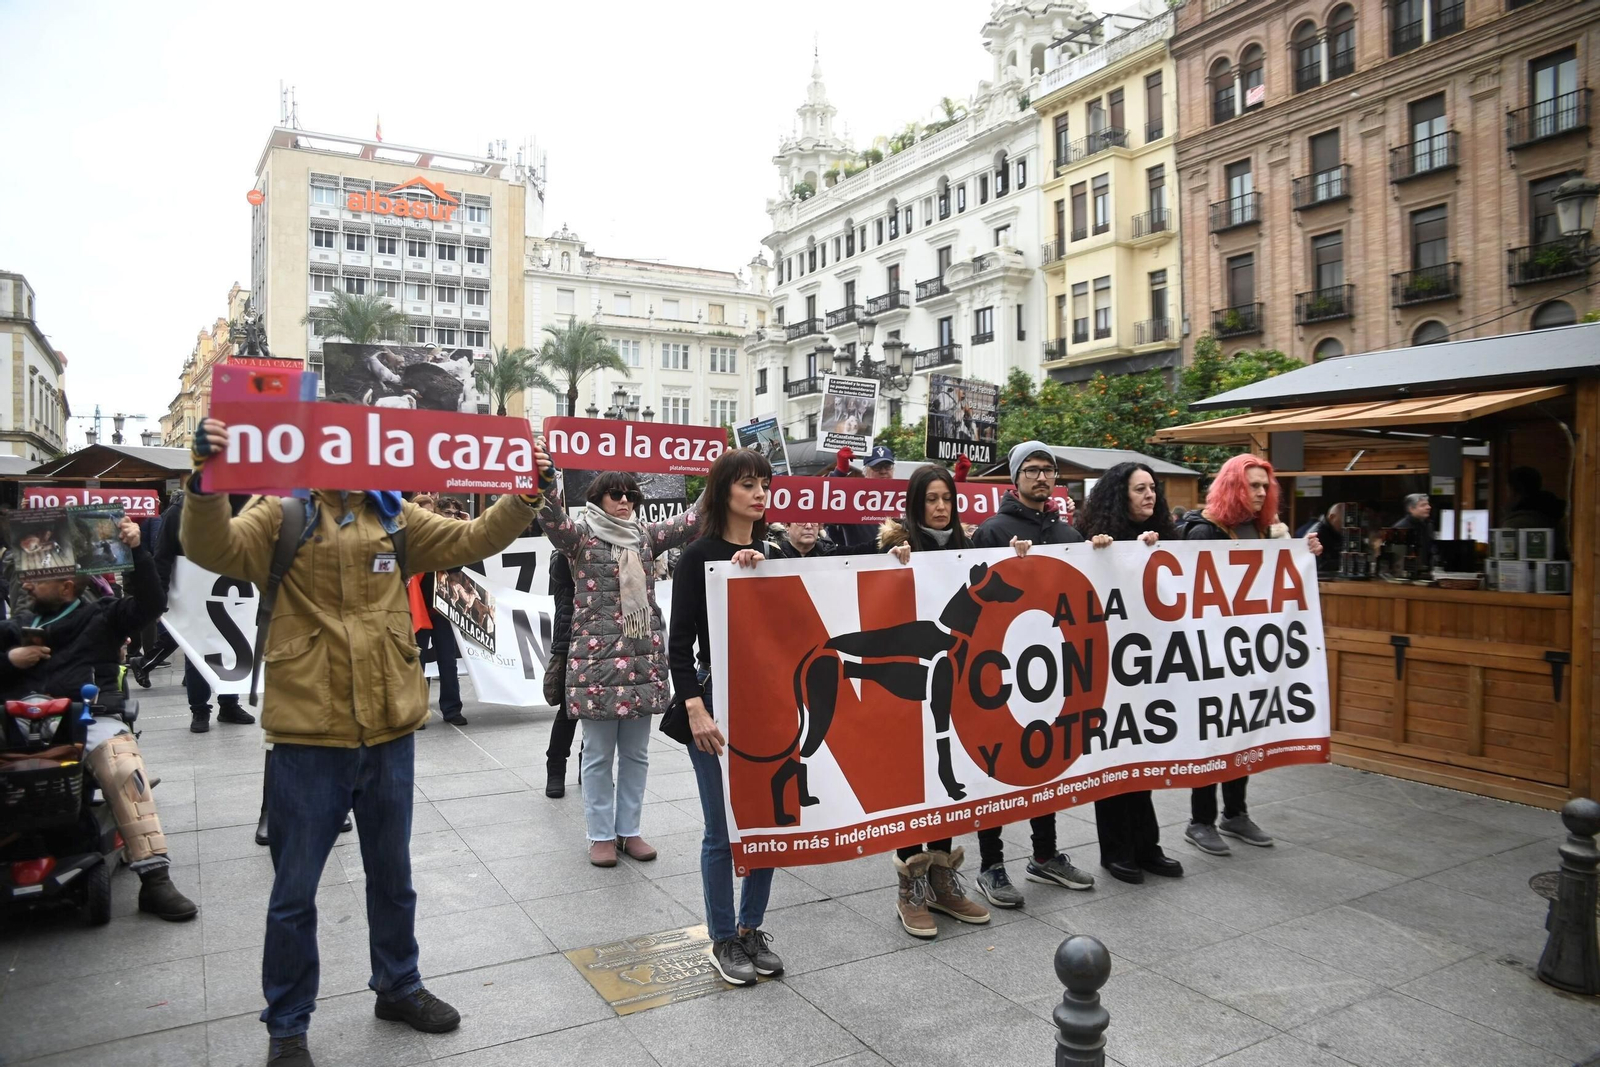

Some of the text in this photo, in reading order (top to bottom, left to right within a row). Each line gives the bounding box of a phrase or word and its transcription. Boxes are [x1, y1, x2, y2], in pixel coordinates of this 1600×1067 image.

[347, 190, 458, 222] albasur
[227, 413, 533, 472] no a la caza
[549, 425, 724, 462] no a la caza
[938, 441, 951, 459] NO
[951, 443, 957, 459] A
[969, 444, 990, 463] CAZA
[446, 478, 513, 490] plataformanac.org
[669, 465, 709, 474] plataformanac.org
[30, 495, 59, 509] no
[798, 489, 815, 510] a
[821, 481, 846, 511] la
[853, 490, 907, 511] caza
[974, 493, 988, 513] a
[1052, 549, 1308, 628] A LA CAZA
[450, 606, 495, 652] NO A LA CAZA
[495, 654, 516, 667] Sur
[968, 620, 1310, 710] CON GALGOS
[978, 682, 1316, 777] Y OTRAS RAZAS
[793, 836, 829, 850] más
[835, 820, 905, 847] indefensa
[909, 811, 941, 830] está
[946, 808, 971, 822] una
[975, 796, 1028, 817] criatura,
[1032, 787, 1054, 804] más
[1056, 775, 1100, 797] derecho
[1102, 770, 1128, 785] tiene
[1132, 769, 1140, 778] a
[1143, 765, 1166, 777] ser
[1170, 759, 1227, 775] defendida
